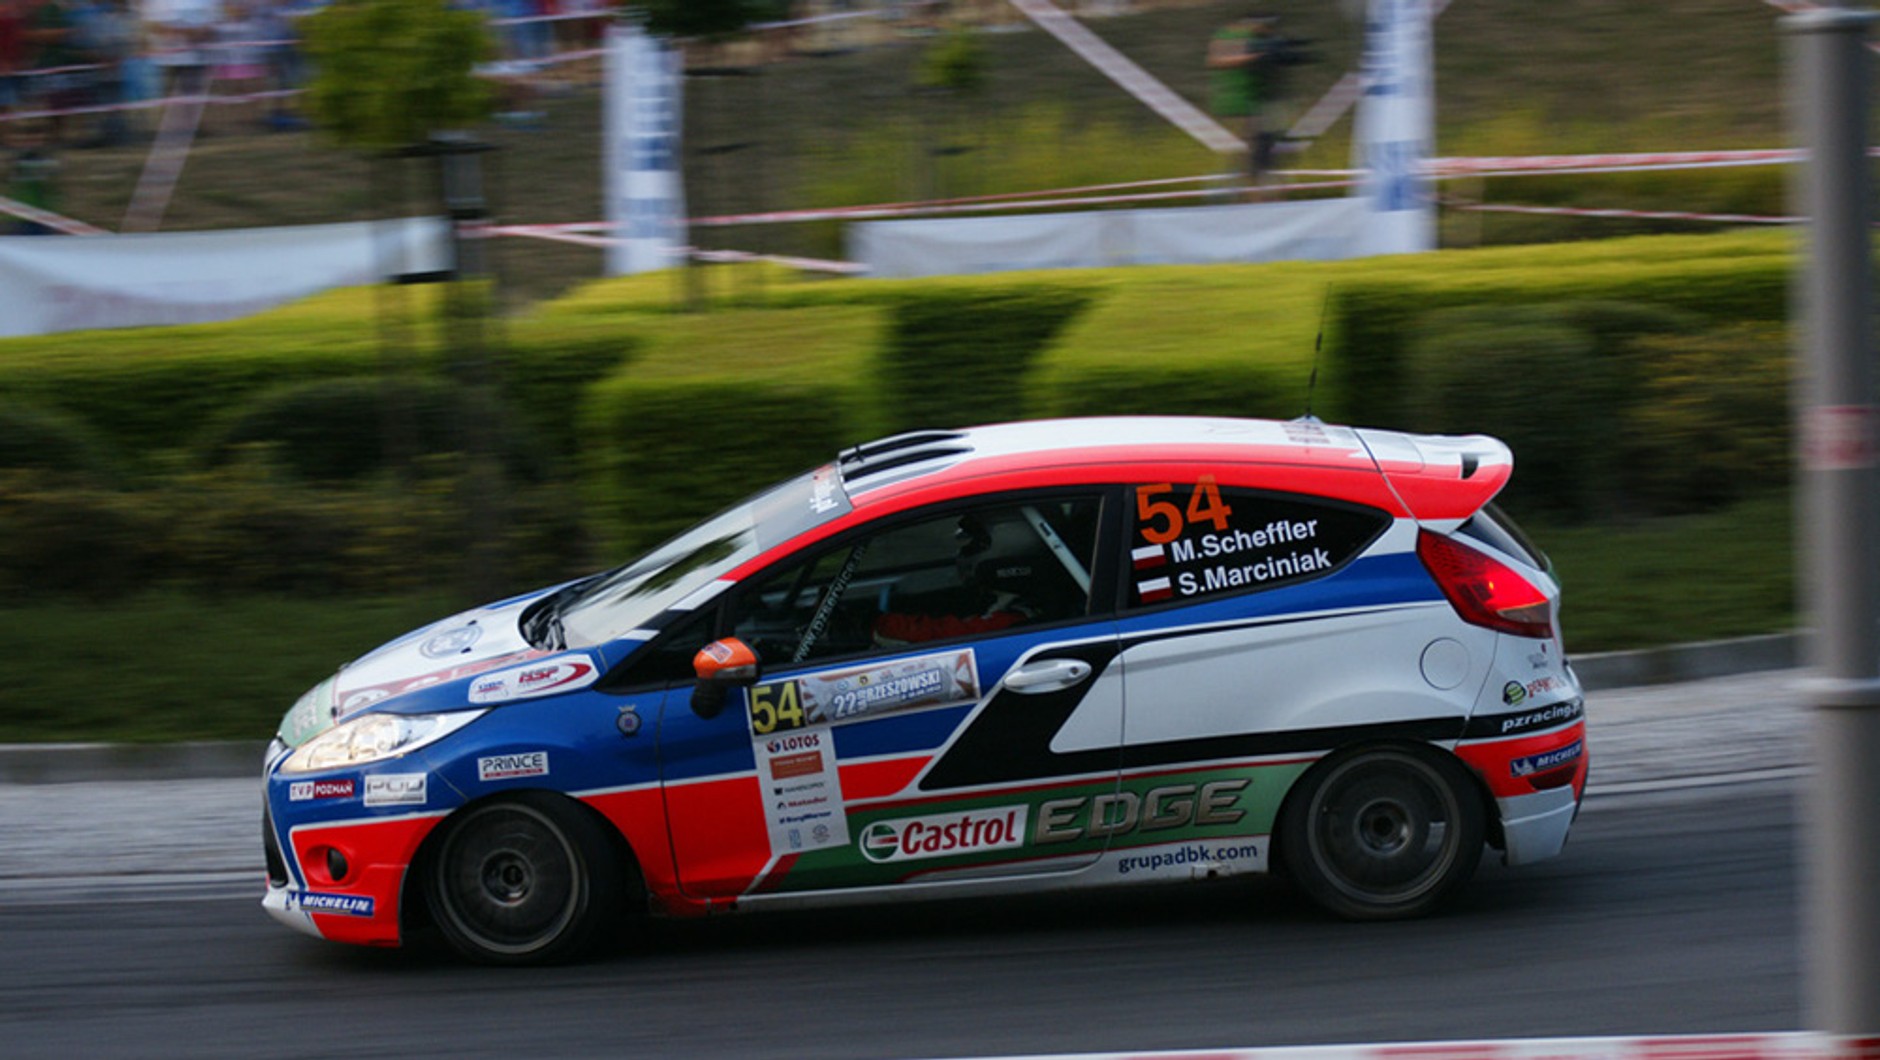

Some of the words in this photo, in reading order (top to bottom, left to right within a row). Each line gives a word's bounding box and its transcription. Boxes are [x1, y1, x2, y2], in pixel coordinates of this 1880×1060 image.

[1136, 474, 1232, 545] 54
[1171, 519, 1318, 564] M.Scheffler
[1178, 547, 1332, 596] S.Marciniak
[752, 680, 803, 734] 54
[833, 691, 857, 718] 22
[866, 669, 941, 700] RZESZOWSKI
[1502, 699, 1582, 733] pzracing.p
[482, 753, 543, 772] PRINCE
[782, 733, 820, 752] LOTOS
[901, 811, 1016, 855] Castrol
[1034, 778, 1252, 845] EDGE
[1118, 845, 1258, 874] grupadbk.com
[302, 894, 371, 912] MICHELIN
